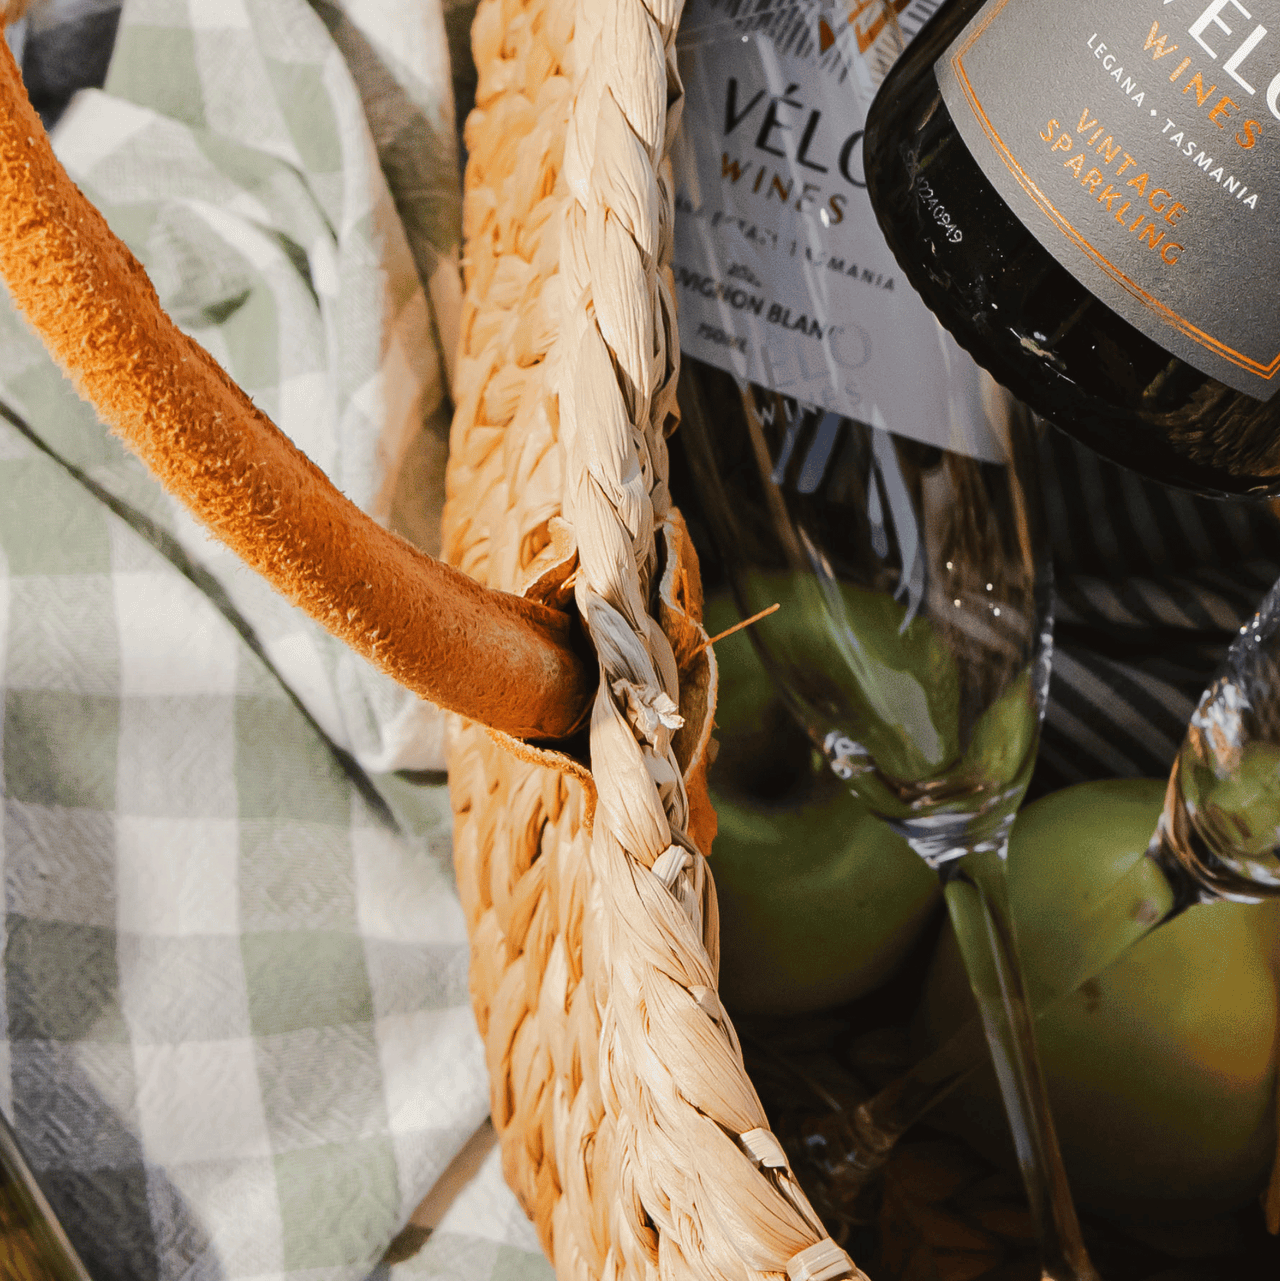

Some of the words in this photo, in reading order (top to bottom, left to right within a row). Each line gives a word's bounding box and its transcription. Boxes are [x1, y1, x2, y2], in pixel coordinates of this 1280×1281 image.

[1086, 32, 1146, 108] LEGANA
[1160, 118, 1259, 210] TASMANIA
[1143, 20, 1263, 150] WINES
[721, 152, 847, 225] WINES
[1039, 118, 1186, 266] SPARKLING
[1076, 107, 1189, 227] VINTAGE
[790, 238, 895, 291] TMANIA
